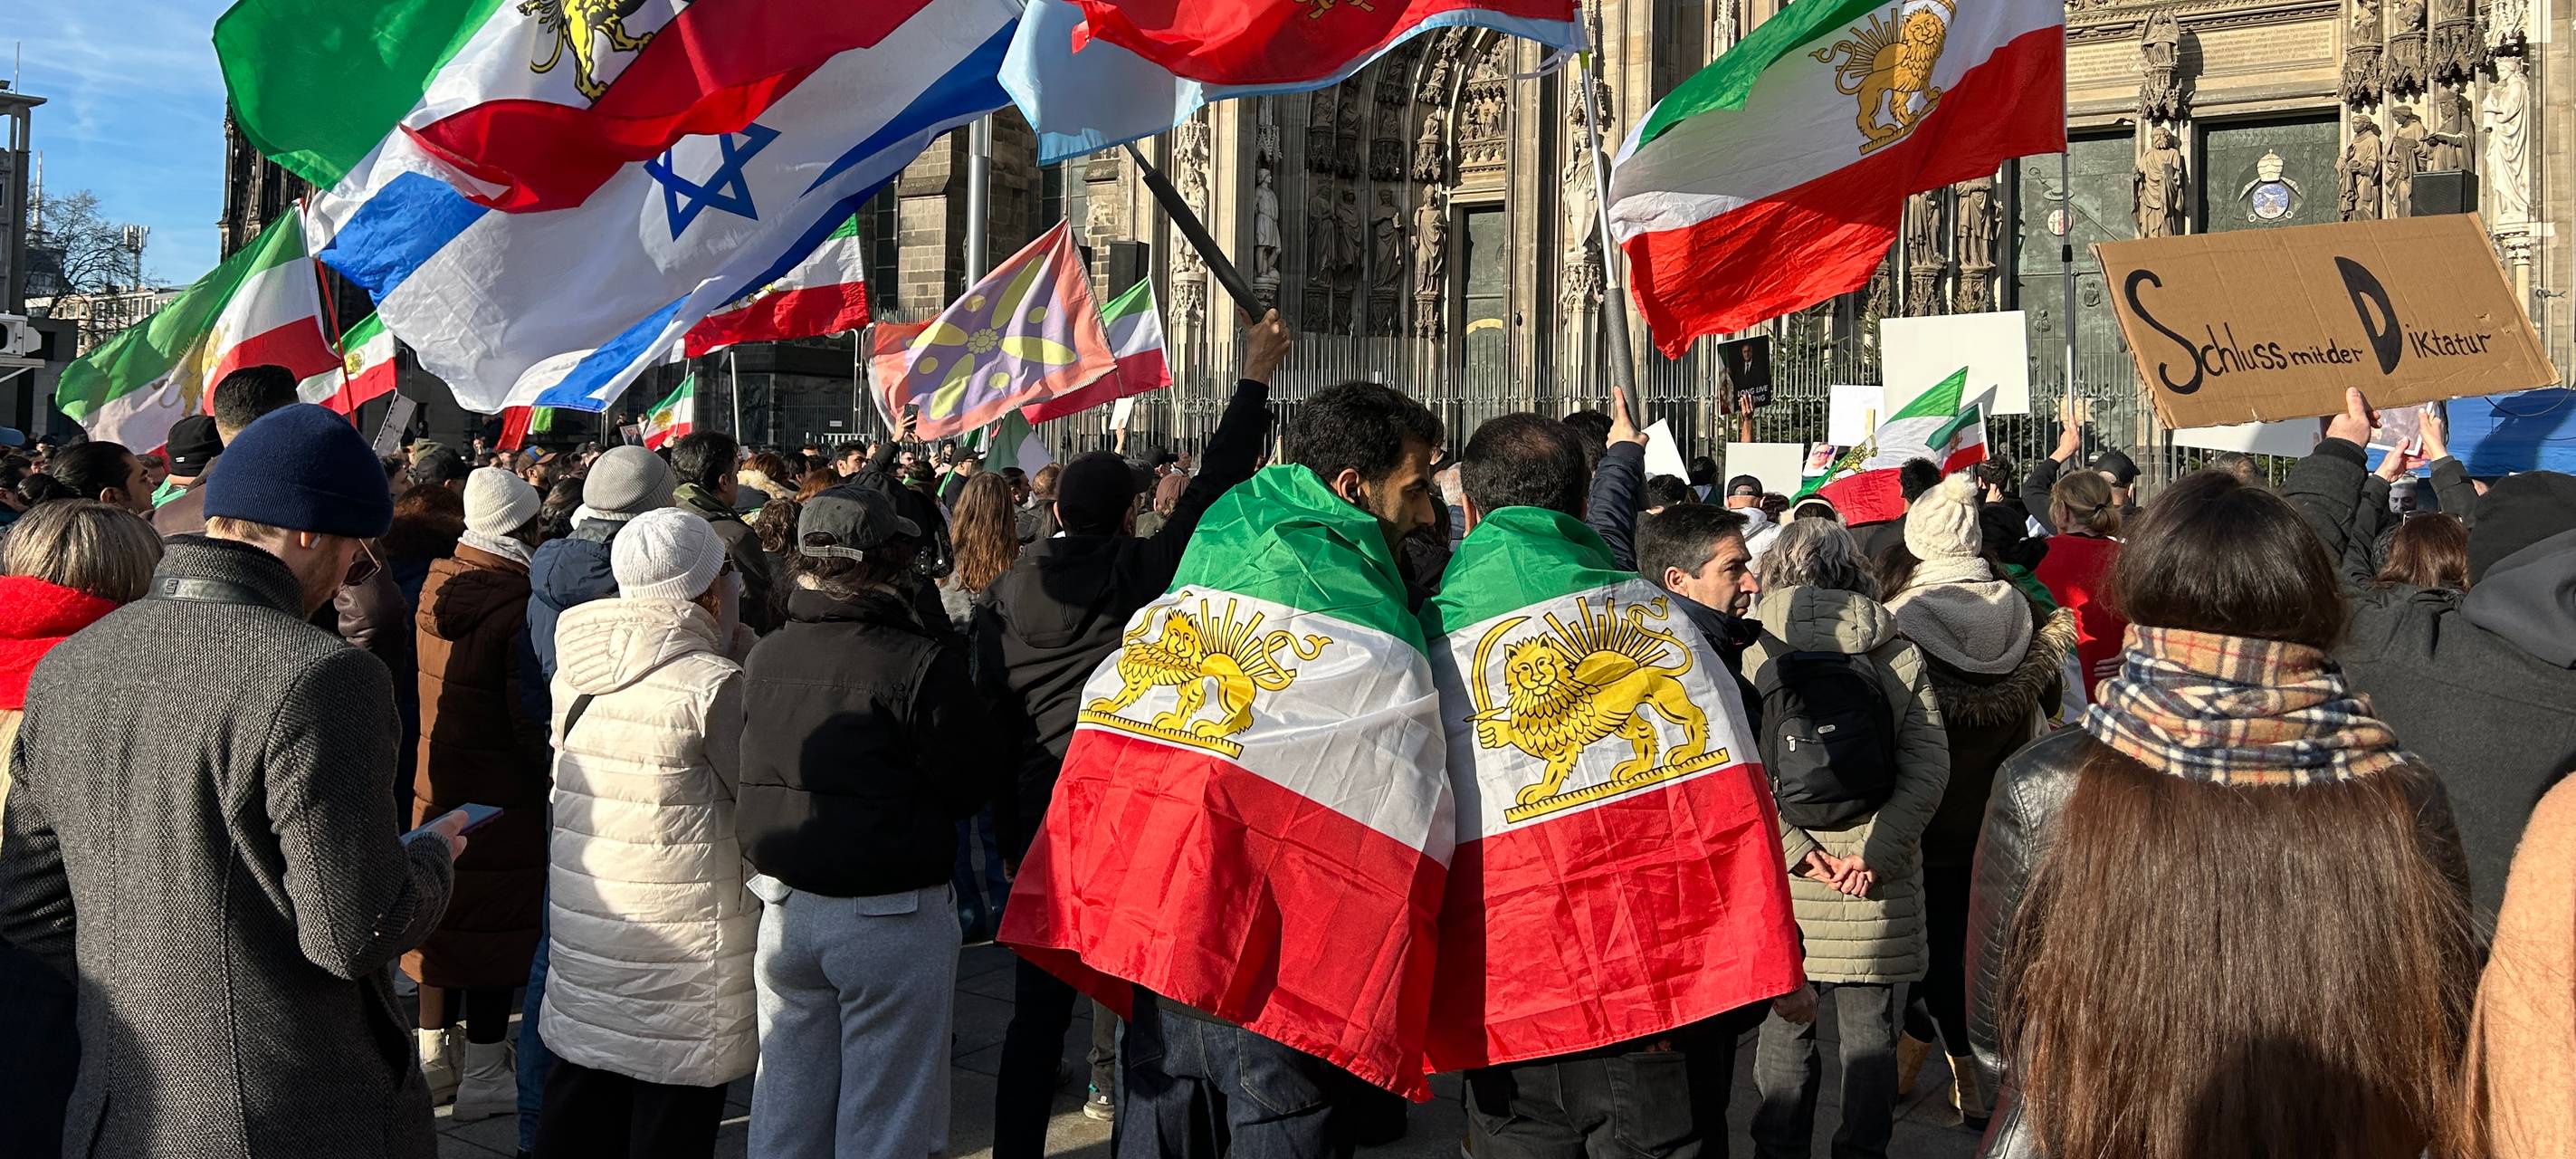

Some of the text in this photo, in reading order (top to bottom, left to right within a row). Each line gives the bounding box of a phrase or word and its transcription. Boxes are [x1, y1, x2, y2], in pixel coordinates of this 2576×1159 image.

[2124, 255, 2492, 395] Schluss mit der Diktatur
[1756, 385, 1769, 393] LIVE
